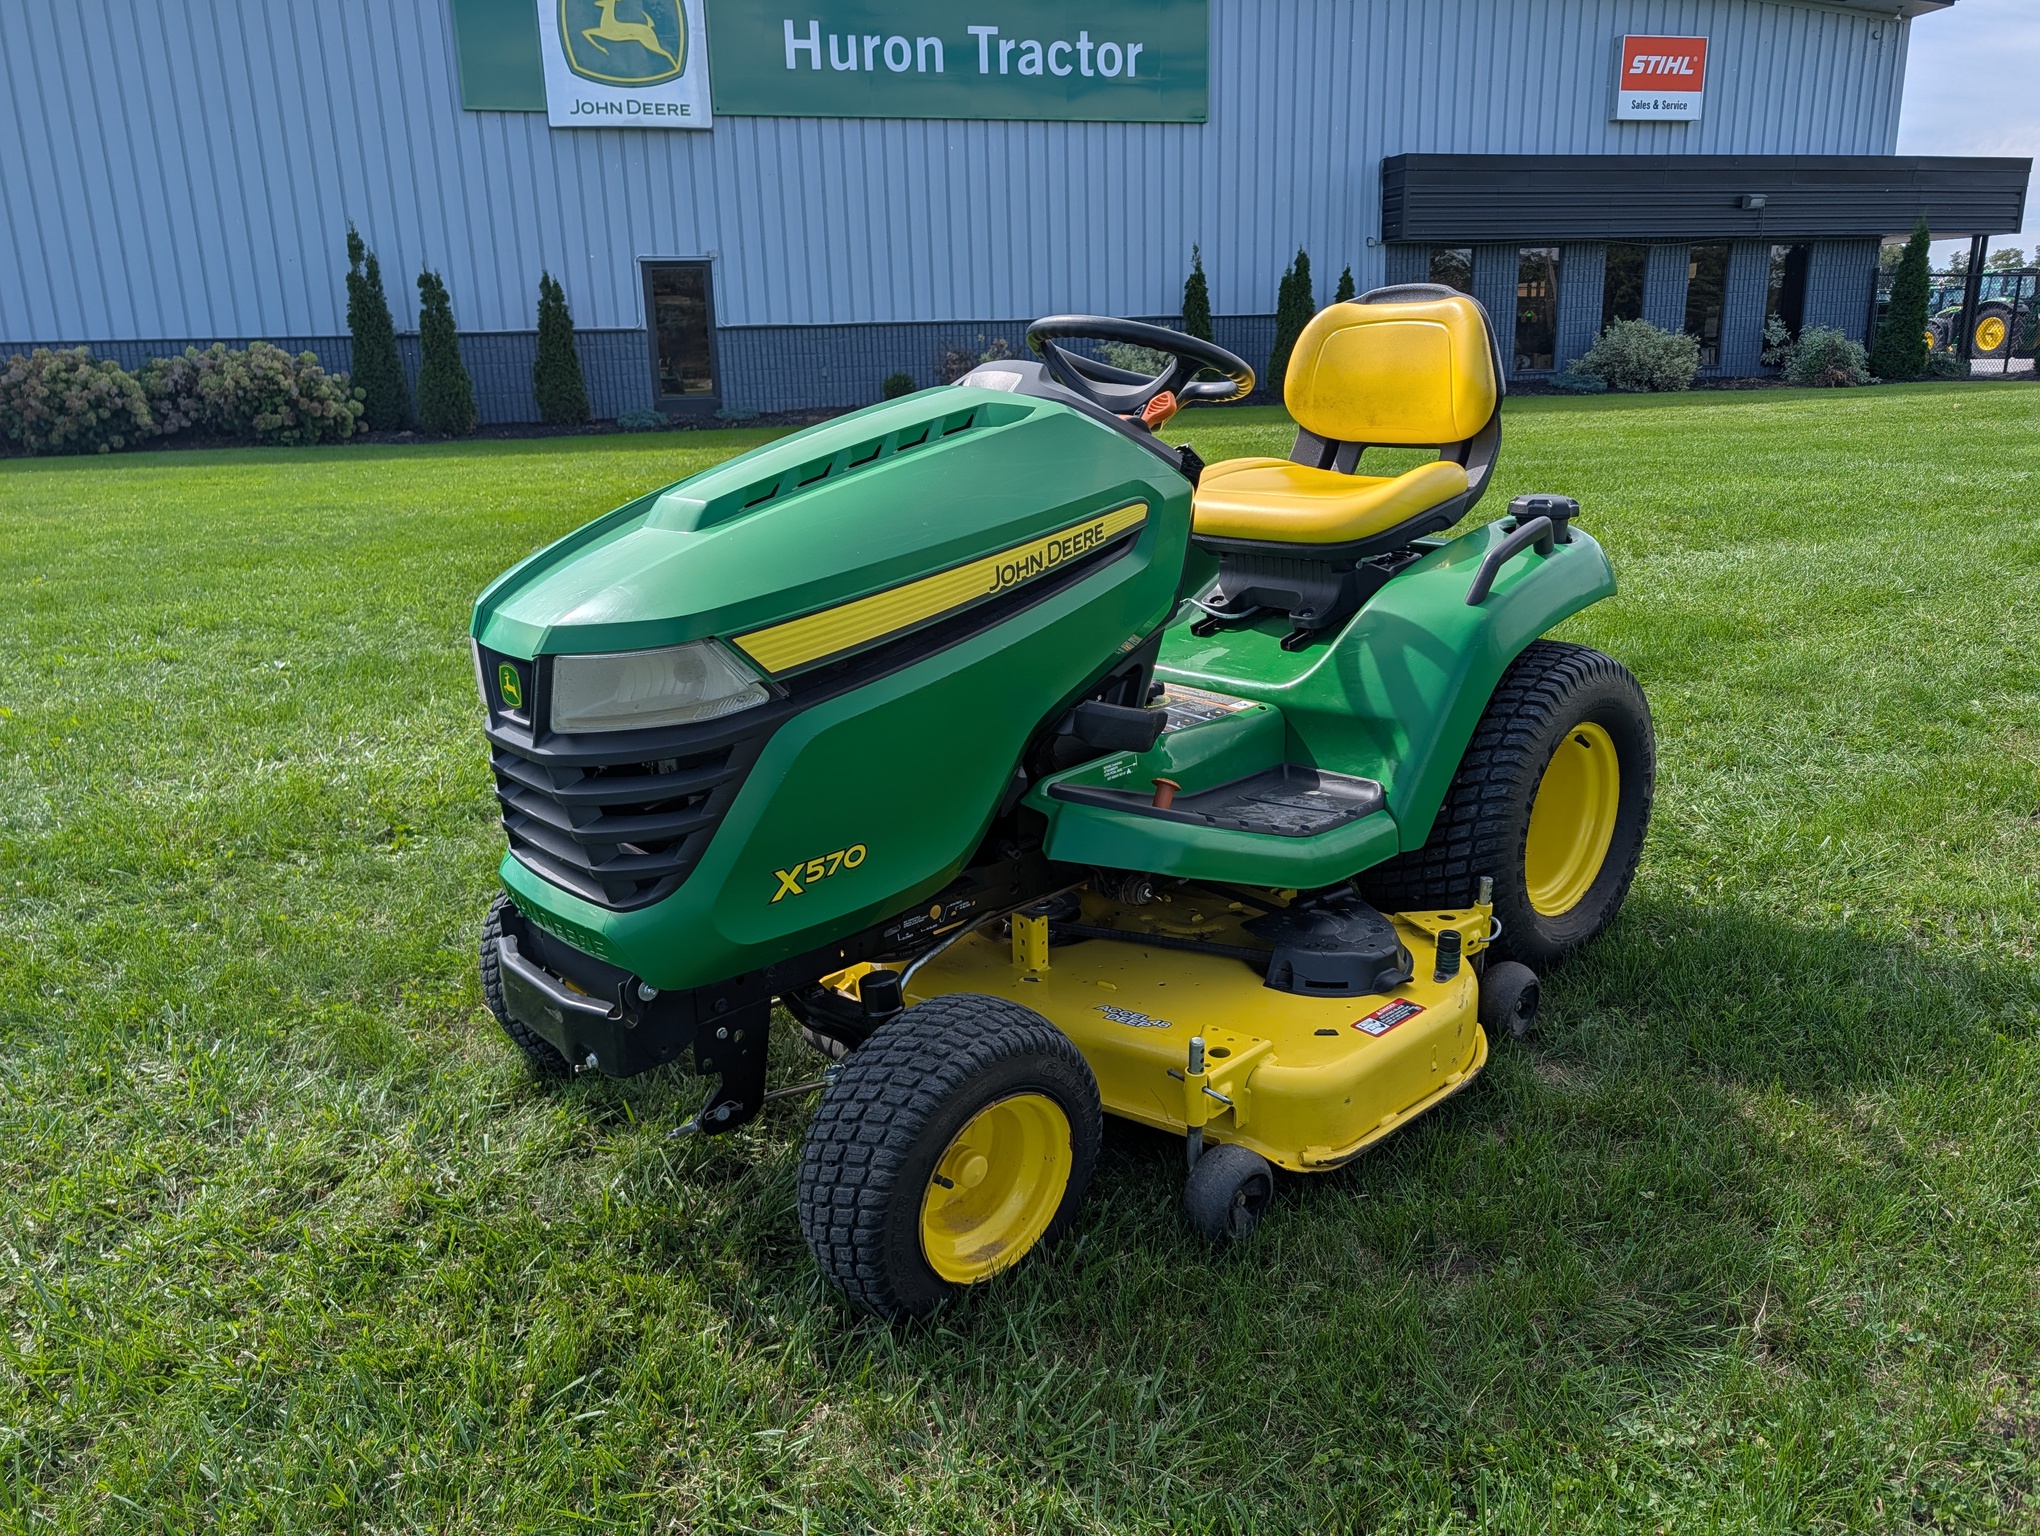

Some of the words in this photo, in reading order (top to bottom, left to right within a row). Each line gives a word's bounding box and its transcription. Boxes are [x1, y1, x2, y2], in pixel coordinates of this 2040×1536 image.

[783, 19, 944, 73] Huron
[967, 25, 1143, 78] Tractor
[1628, 54, 1694, 75] STIHL
[570, 99, 623, 115] JOHN
[626, 99, 692, 117] DEERE
[1631, 99, 1651, 110] Sales
[1652, 99, 1660, 110] &
[1661, 100, 1688, 111] Service
[989, 551, 1043, 593] JOHN
[1047, 522, 1106, 565] DEERE
[768, 843, 867, 905] X570
[1093, 1005, 1150, 1021] ACCEL
[1103, 1013, 1152, 1028] DEEP
[1040, 1060, 1095, 1158] CARLISL
